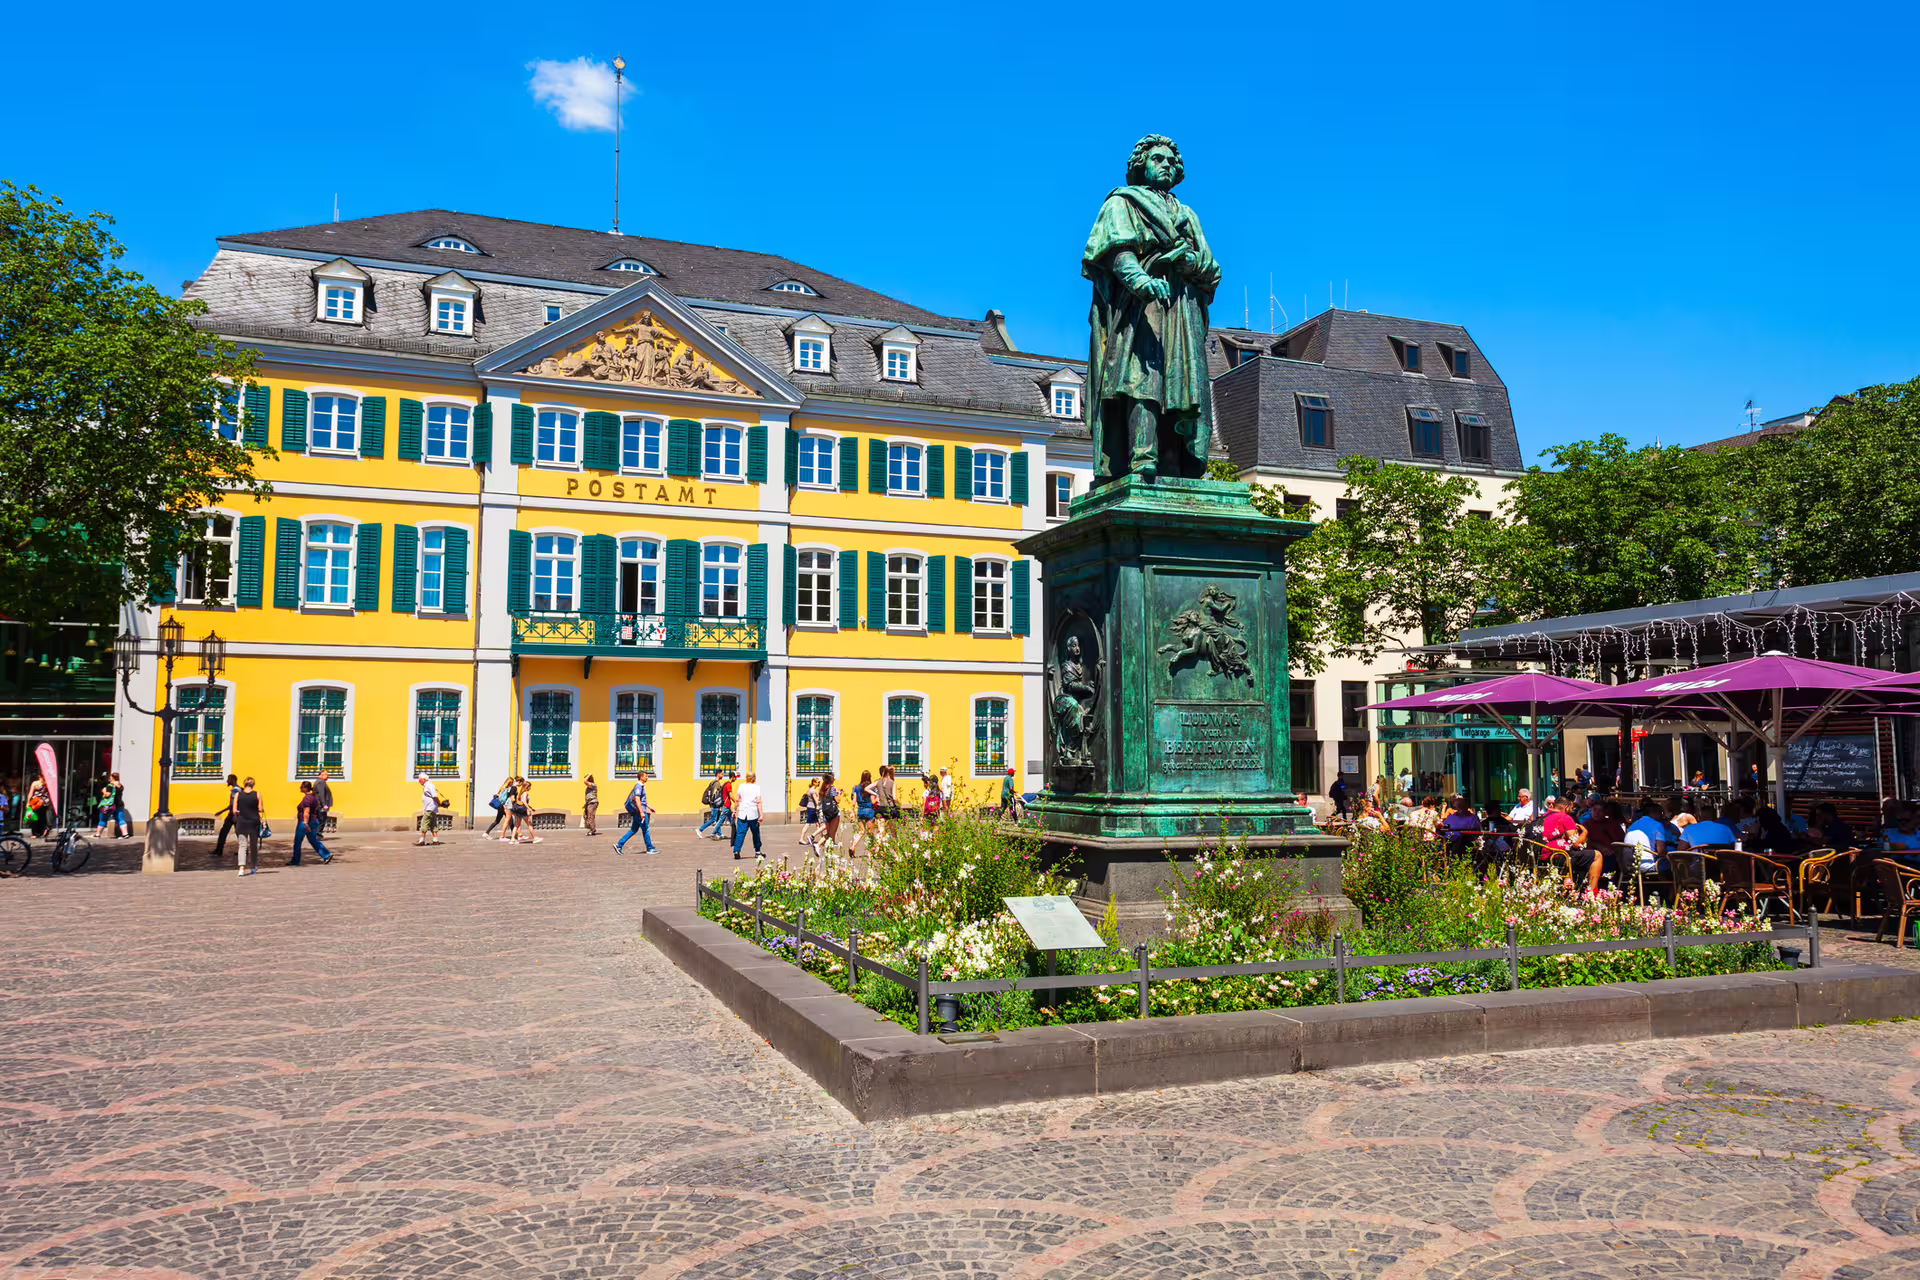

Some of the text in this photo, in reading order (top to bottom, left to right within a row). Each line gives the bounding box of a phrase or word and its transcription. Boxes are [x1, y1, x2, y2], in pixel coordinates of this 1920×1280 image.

[566, 478, 717, 505] POSTAMT
[1180, 712, 1241, 727] LUDWIG
[1460, 728, 1491, 739] Tiefgarage
